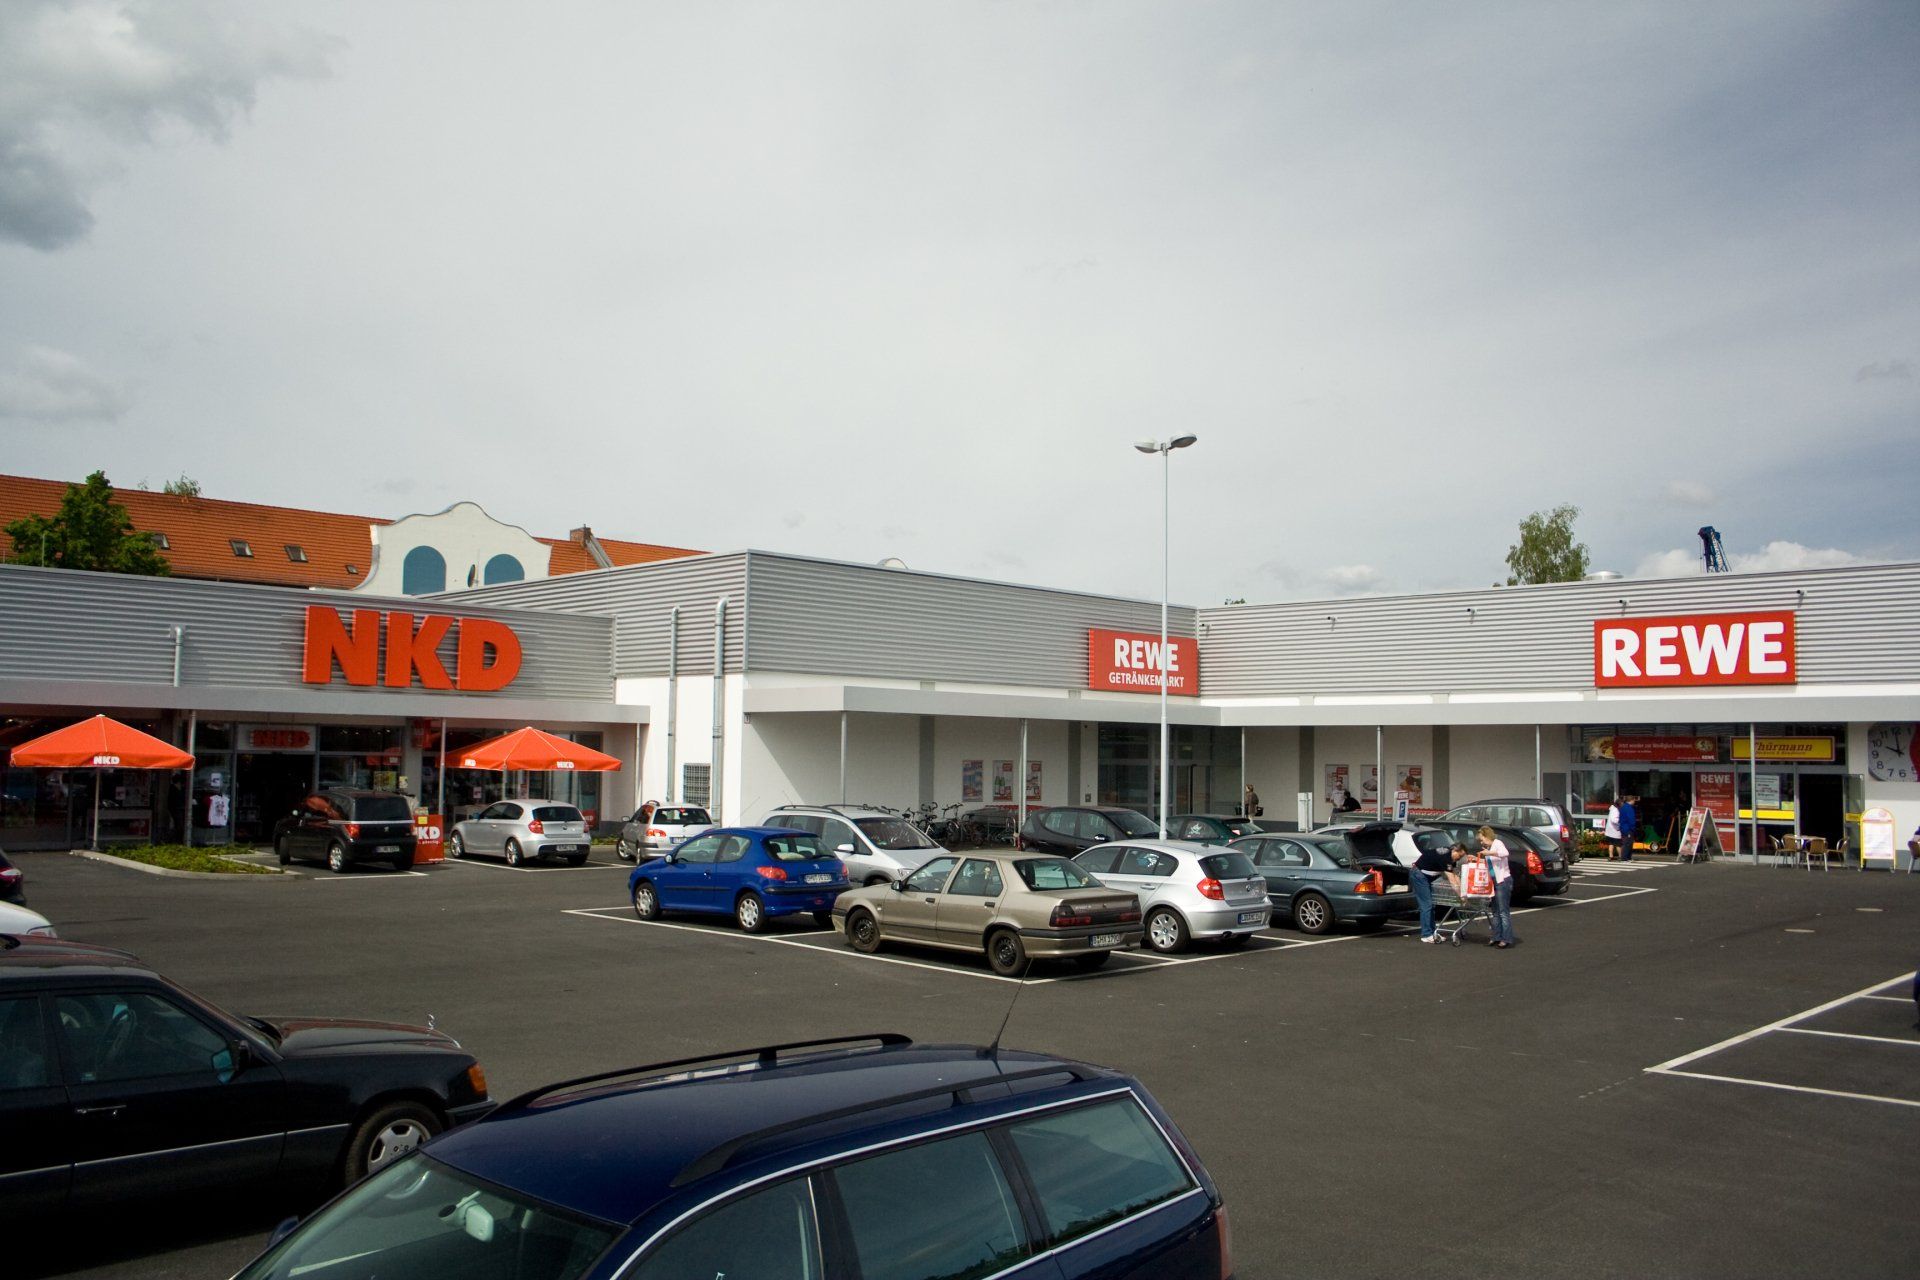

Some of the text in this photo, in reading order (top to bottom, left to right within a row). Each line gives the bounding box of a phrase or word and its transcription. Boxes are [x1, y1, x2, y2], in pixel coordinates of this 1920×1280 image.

[302, 605, 522, 691] NKD
[1114, 638, 1179, 672] REWE
[1601, 621, 1787, 678] REWE
[1109, 671, 1184, 687] GETRÄNKEMRKT
[250, 730, 311, 748] NKD
[93, 755, 120, 765] NKD
[1701, 775, 1730, 784] REWE
